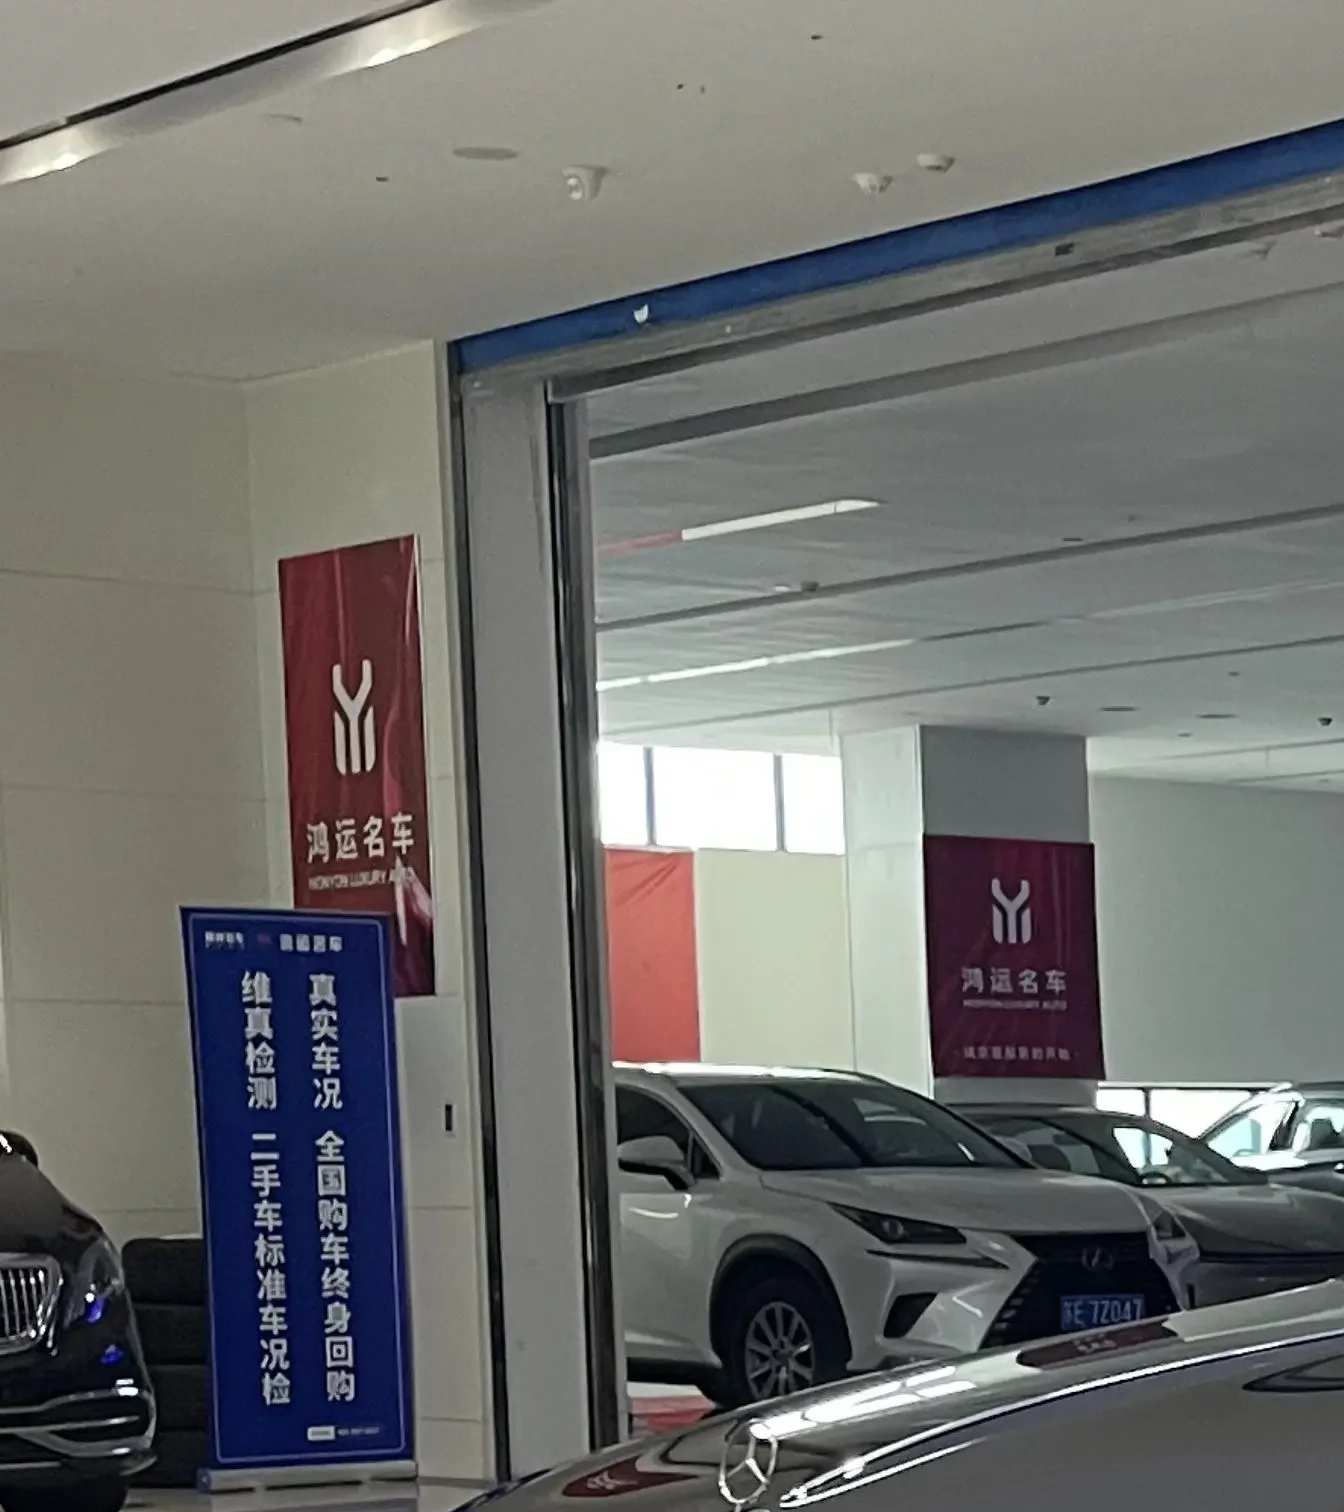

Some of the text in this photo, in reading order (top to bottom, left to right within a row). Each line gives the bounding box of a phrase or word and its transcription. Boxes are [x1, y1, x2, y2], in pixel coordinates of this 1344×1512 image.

[306, 811, 415, 864] 鸿运名车
[307, 972, 343, 1111] 真实车况
[241, 970, 291, 1406] 维真检测 二手车标准车况检
[314, 1129, 356, 1403] 全国购车终身回购
